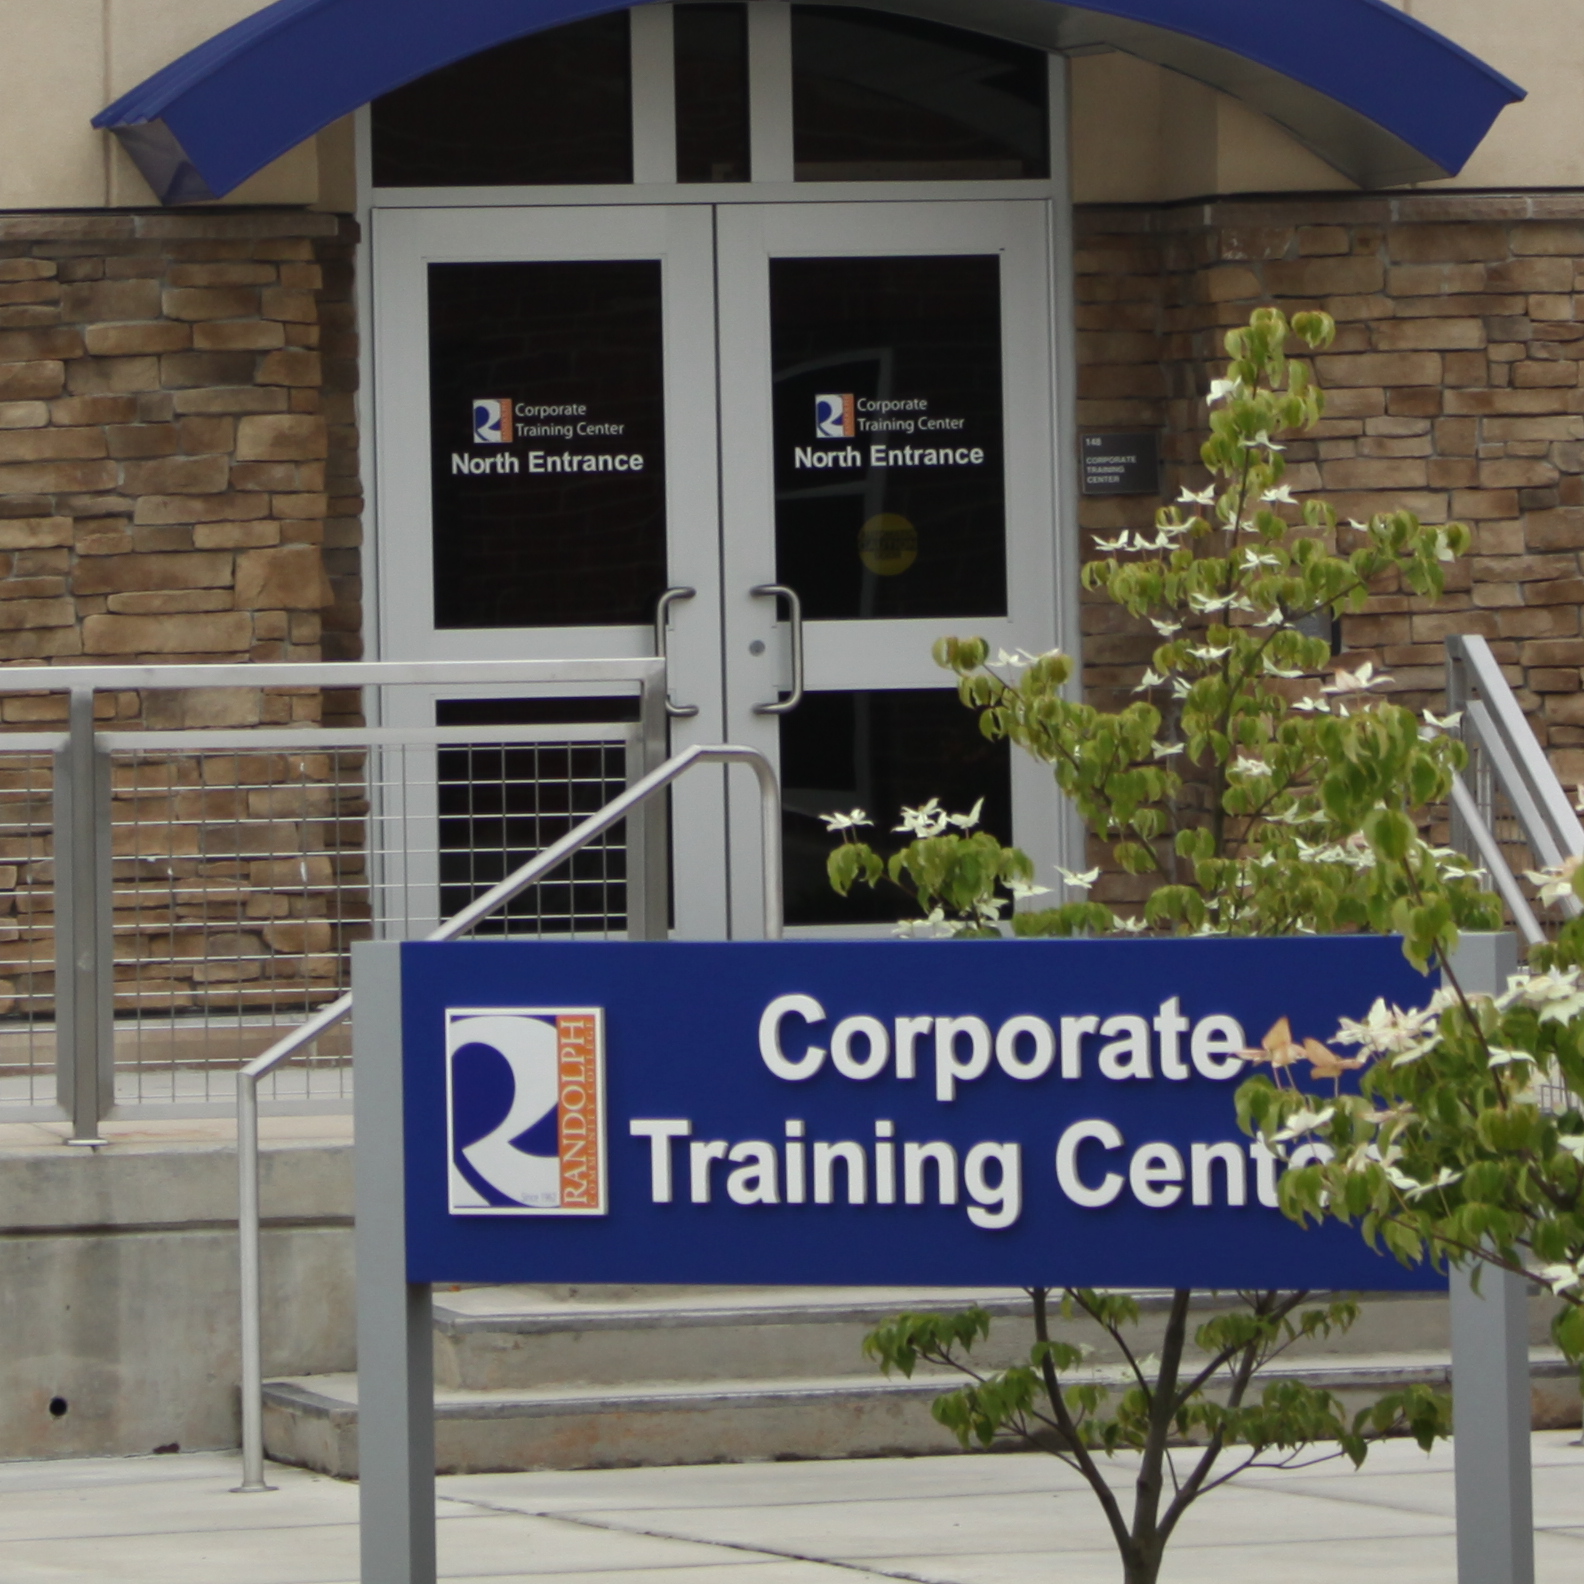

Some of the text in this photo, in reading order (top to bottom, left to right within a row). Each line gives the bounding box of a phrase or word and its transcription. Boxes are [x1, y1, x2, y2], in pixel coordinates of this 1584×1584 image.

[514, 402, 587, 419] Corporate
[856, 397, 928, 415] Corporate
[515, 421, 625, 440] Training Center
[856, 416, 965, 434] Training Center
[451, 450, 644, 475] North Entrance
[794, 444, 984, 469] North Entrance
[1085, 455, 1136, 464] CORPORATE
[1086, 465, 1125, 474] TRAINING
[1086, 475, 1120, 484] CENTER
[757, 993, 1247, 1103] Corporate
[559, 1020, 588, 1204] RANDOLPH
[585, 1021, 597, 1206] COMMUNITY COLLEGE
[629, 1118, 1382, 1229] Training Cent
